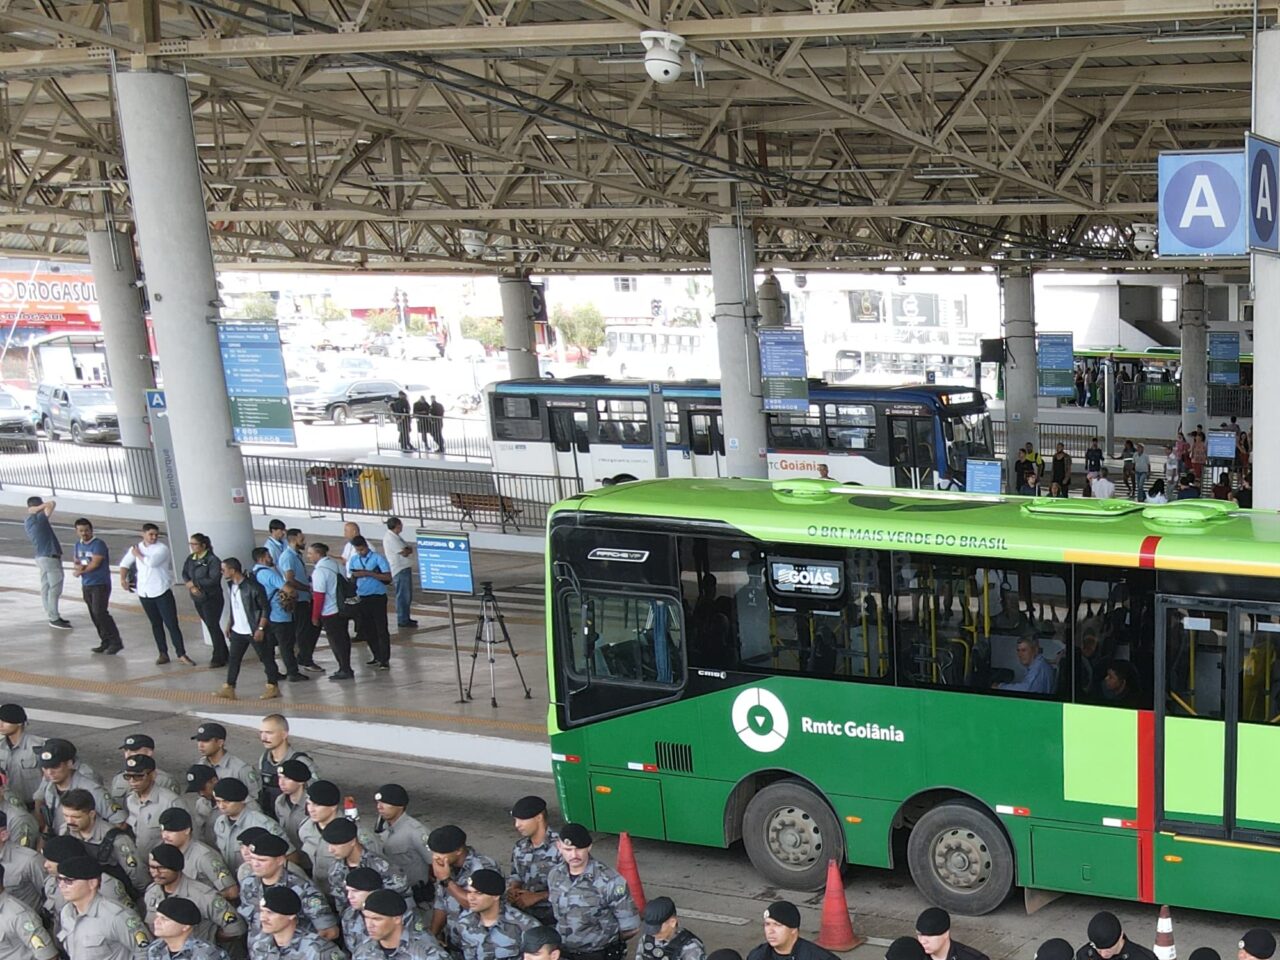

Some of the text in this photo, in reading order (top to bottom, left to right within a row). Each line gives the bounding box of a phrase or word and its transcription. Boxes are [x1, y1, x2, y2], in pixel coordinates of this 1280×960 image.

[1179, 175, 1226, 228] A
[1256, 164, 1272, 222] A
[16, 281, 98, 302] DROGASUL
[152, 393, 164, 406] A
[163, 448, 179, 510] Desembarque
[807, 525, 1008, 550] O BRT MAIS VERDE DO BRASIL
[788, 568, 833, 586] GOIÁS
[801, 717, 905, 742] Rmtc Goiânia
